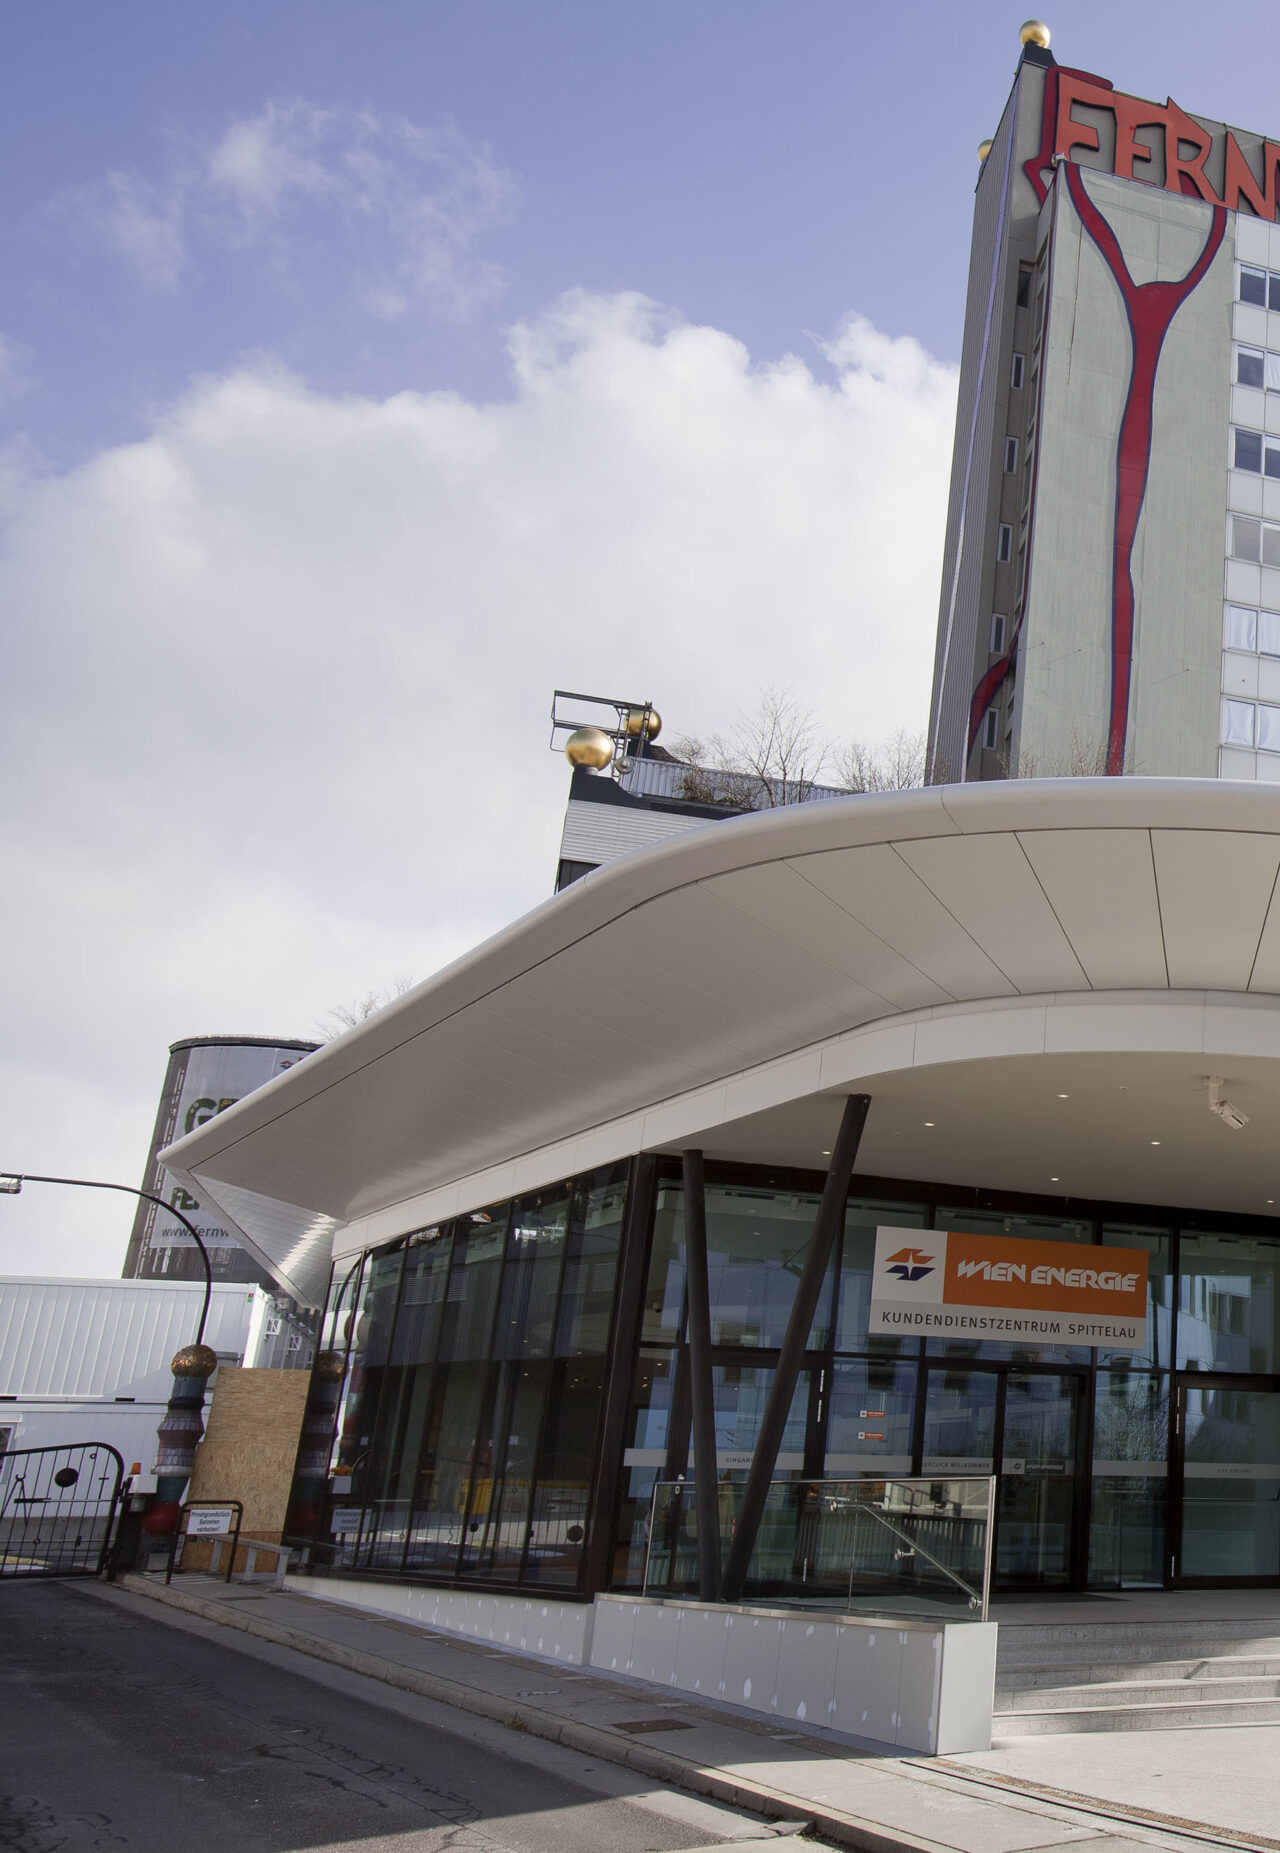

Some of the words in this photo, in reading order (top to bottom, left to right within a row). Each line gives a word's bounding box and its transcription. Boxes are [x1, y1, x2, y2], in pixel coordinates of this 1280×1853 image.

[957, 1260, 1027, 1284] WIEN
[1031, 1265, 1140, 1292] ENERGIE
[882, 1311, 1061, 1334] KUNDENDIENSTZENTRUM
[1068, 1323, 1136, 1338] SPITTELAU
